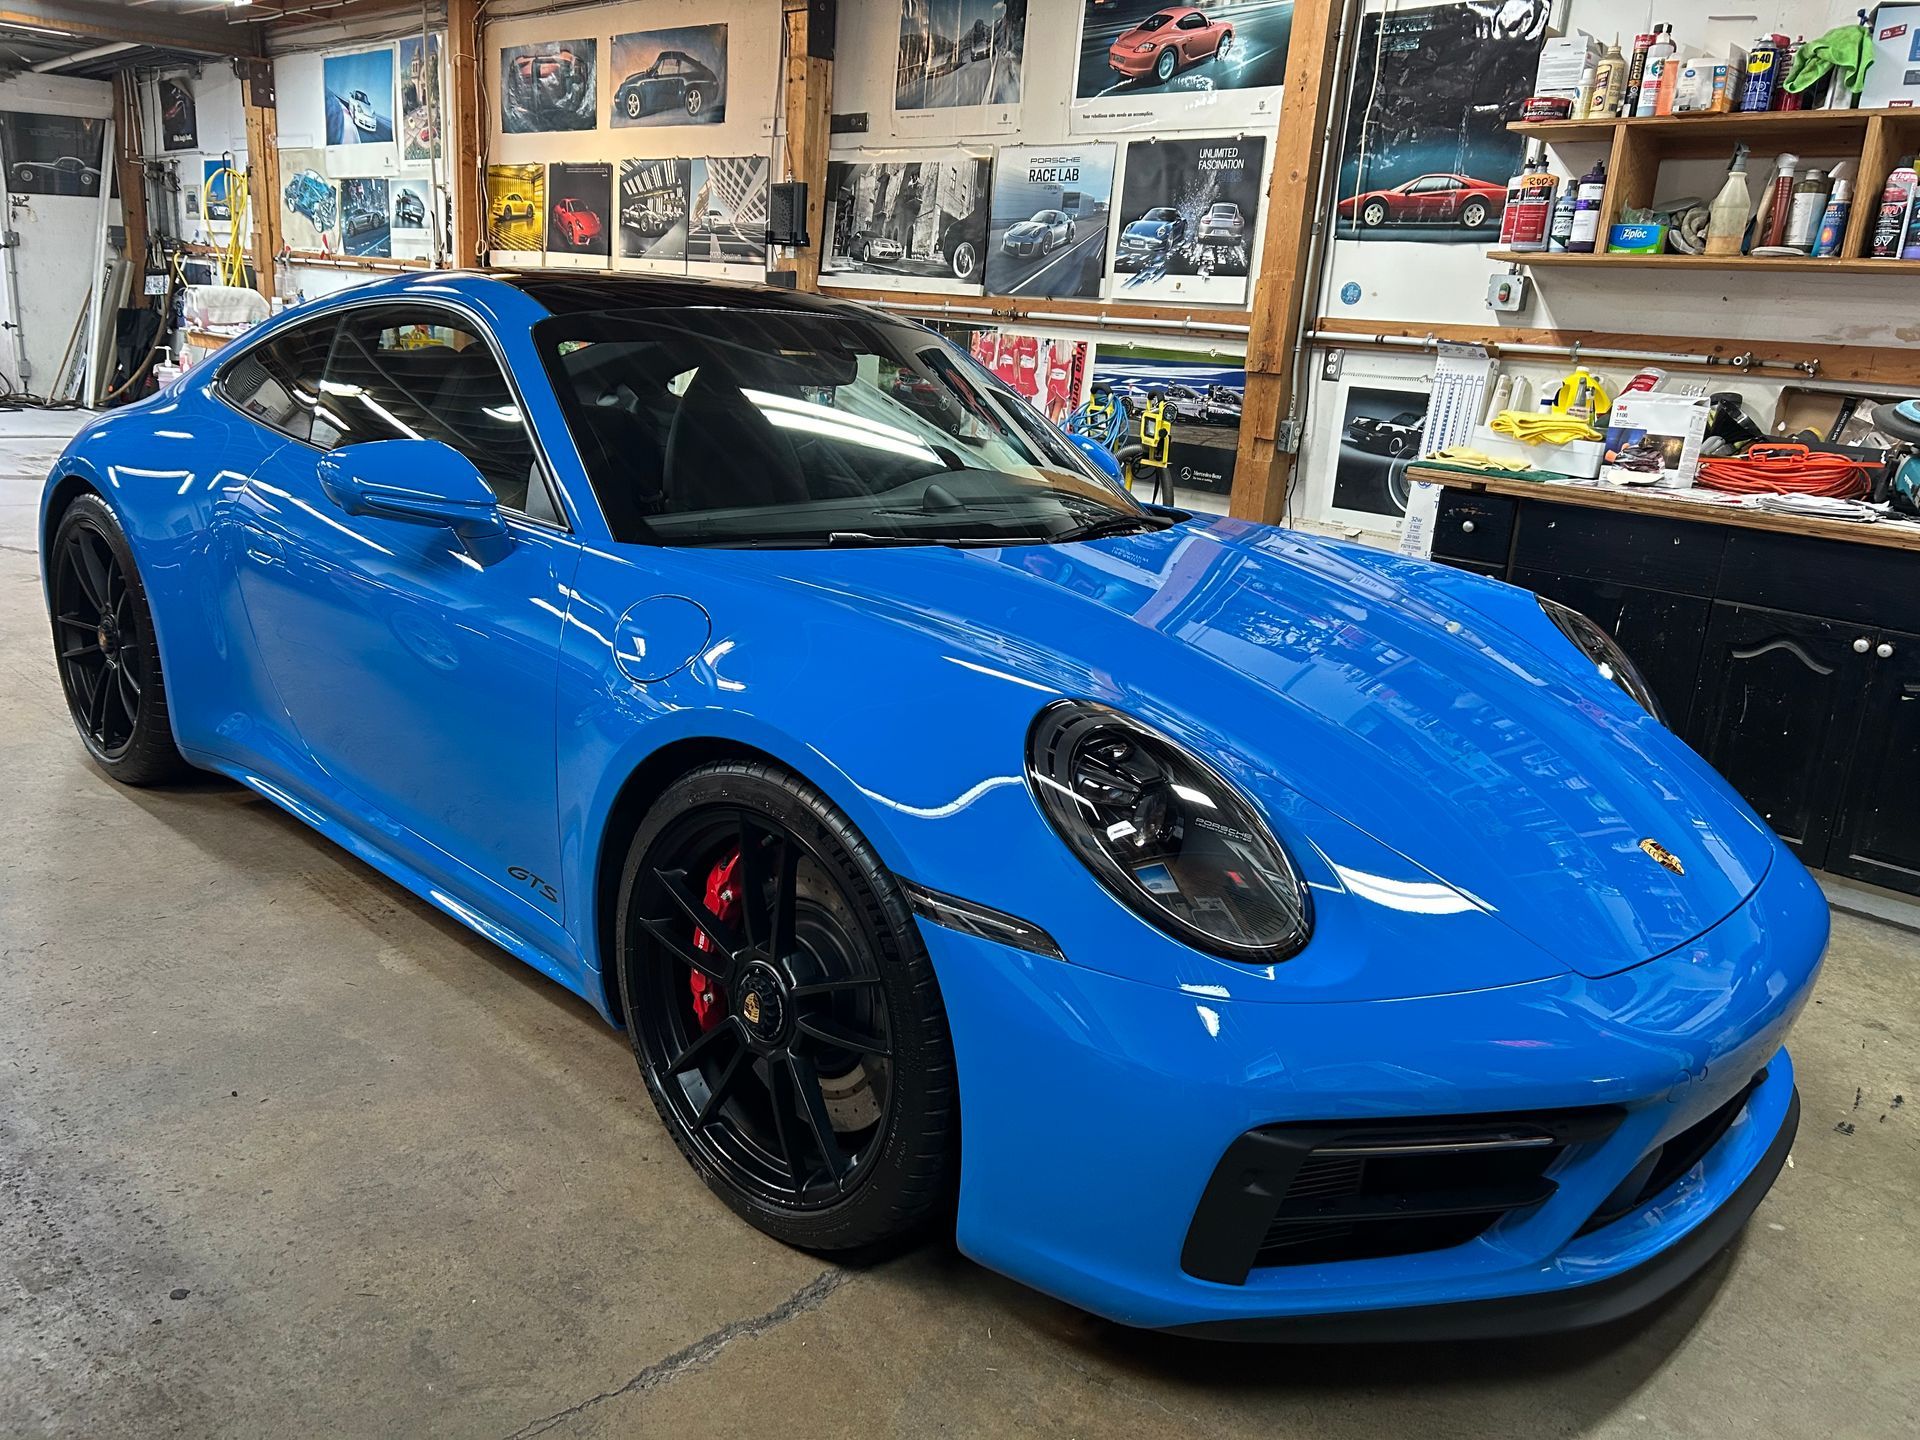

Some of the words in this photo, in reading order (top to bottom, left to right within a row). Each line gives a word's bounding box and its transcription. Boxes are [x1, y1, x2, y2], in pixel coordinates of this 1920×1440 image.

[1199, 147, 1239, 159] UNLIMITED
[1030, 156, 1081, 164] PORSCHE
[1198, 158, 1245, 170] FASCINATION
[1028, 168, 1057, 182] RACE
[1058, 168, 1080, 182] LAB
[1622, 228, 1648, 240] Ziploc
[1074, 342, 1086, 374] Viva
[1195, 817, 1253, 839] PORSCHE
[507, 865, 559, 904] GTS
